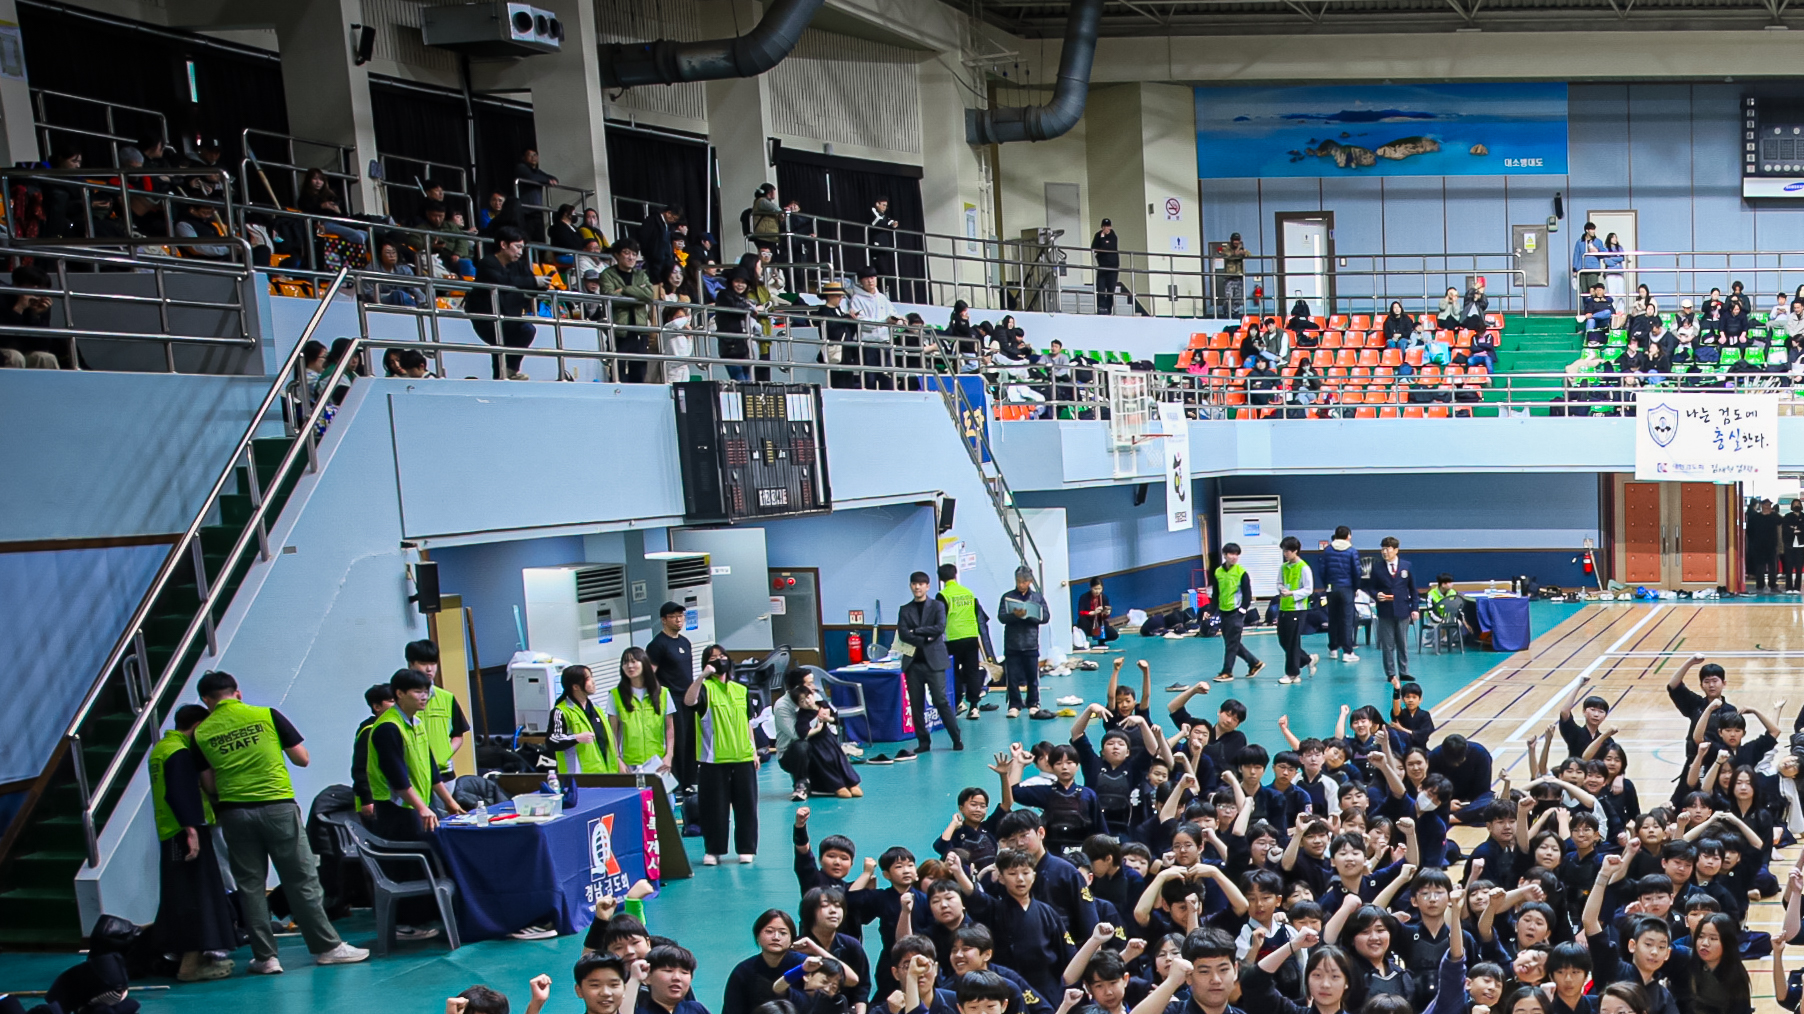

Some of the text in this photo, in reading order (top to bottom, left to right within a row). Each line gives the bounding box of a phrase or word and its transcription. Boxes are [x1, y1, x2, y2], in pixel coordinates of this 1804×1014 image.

[1686, 407, 1758, 425] 나는 검도에
[219, 735, 260, 755] STAFF
[585, 872, 630, 903] 경남검도회
